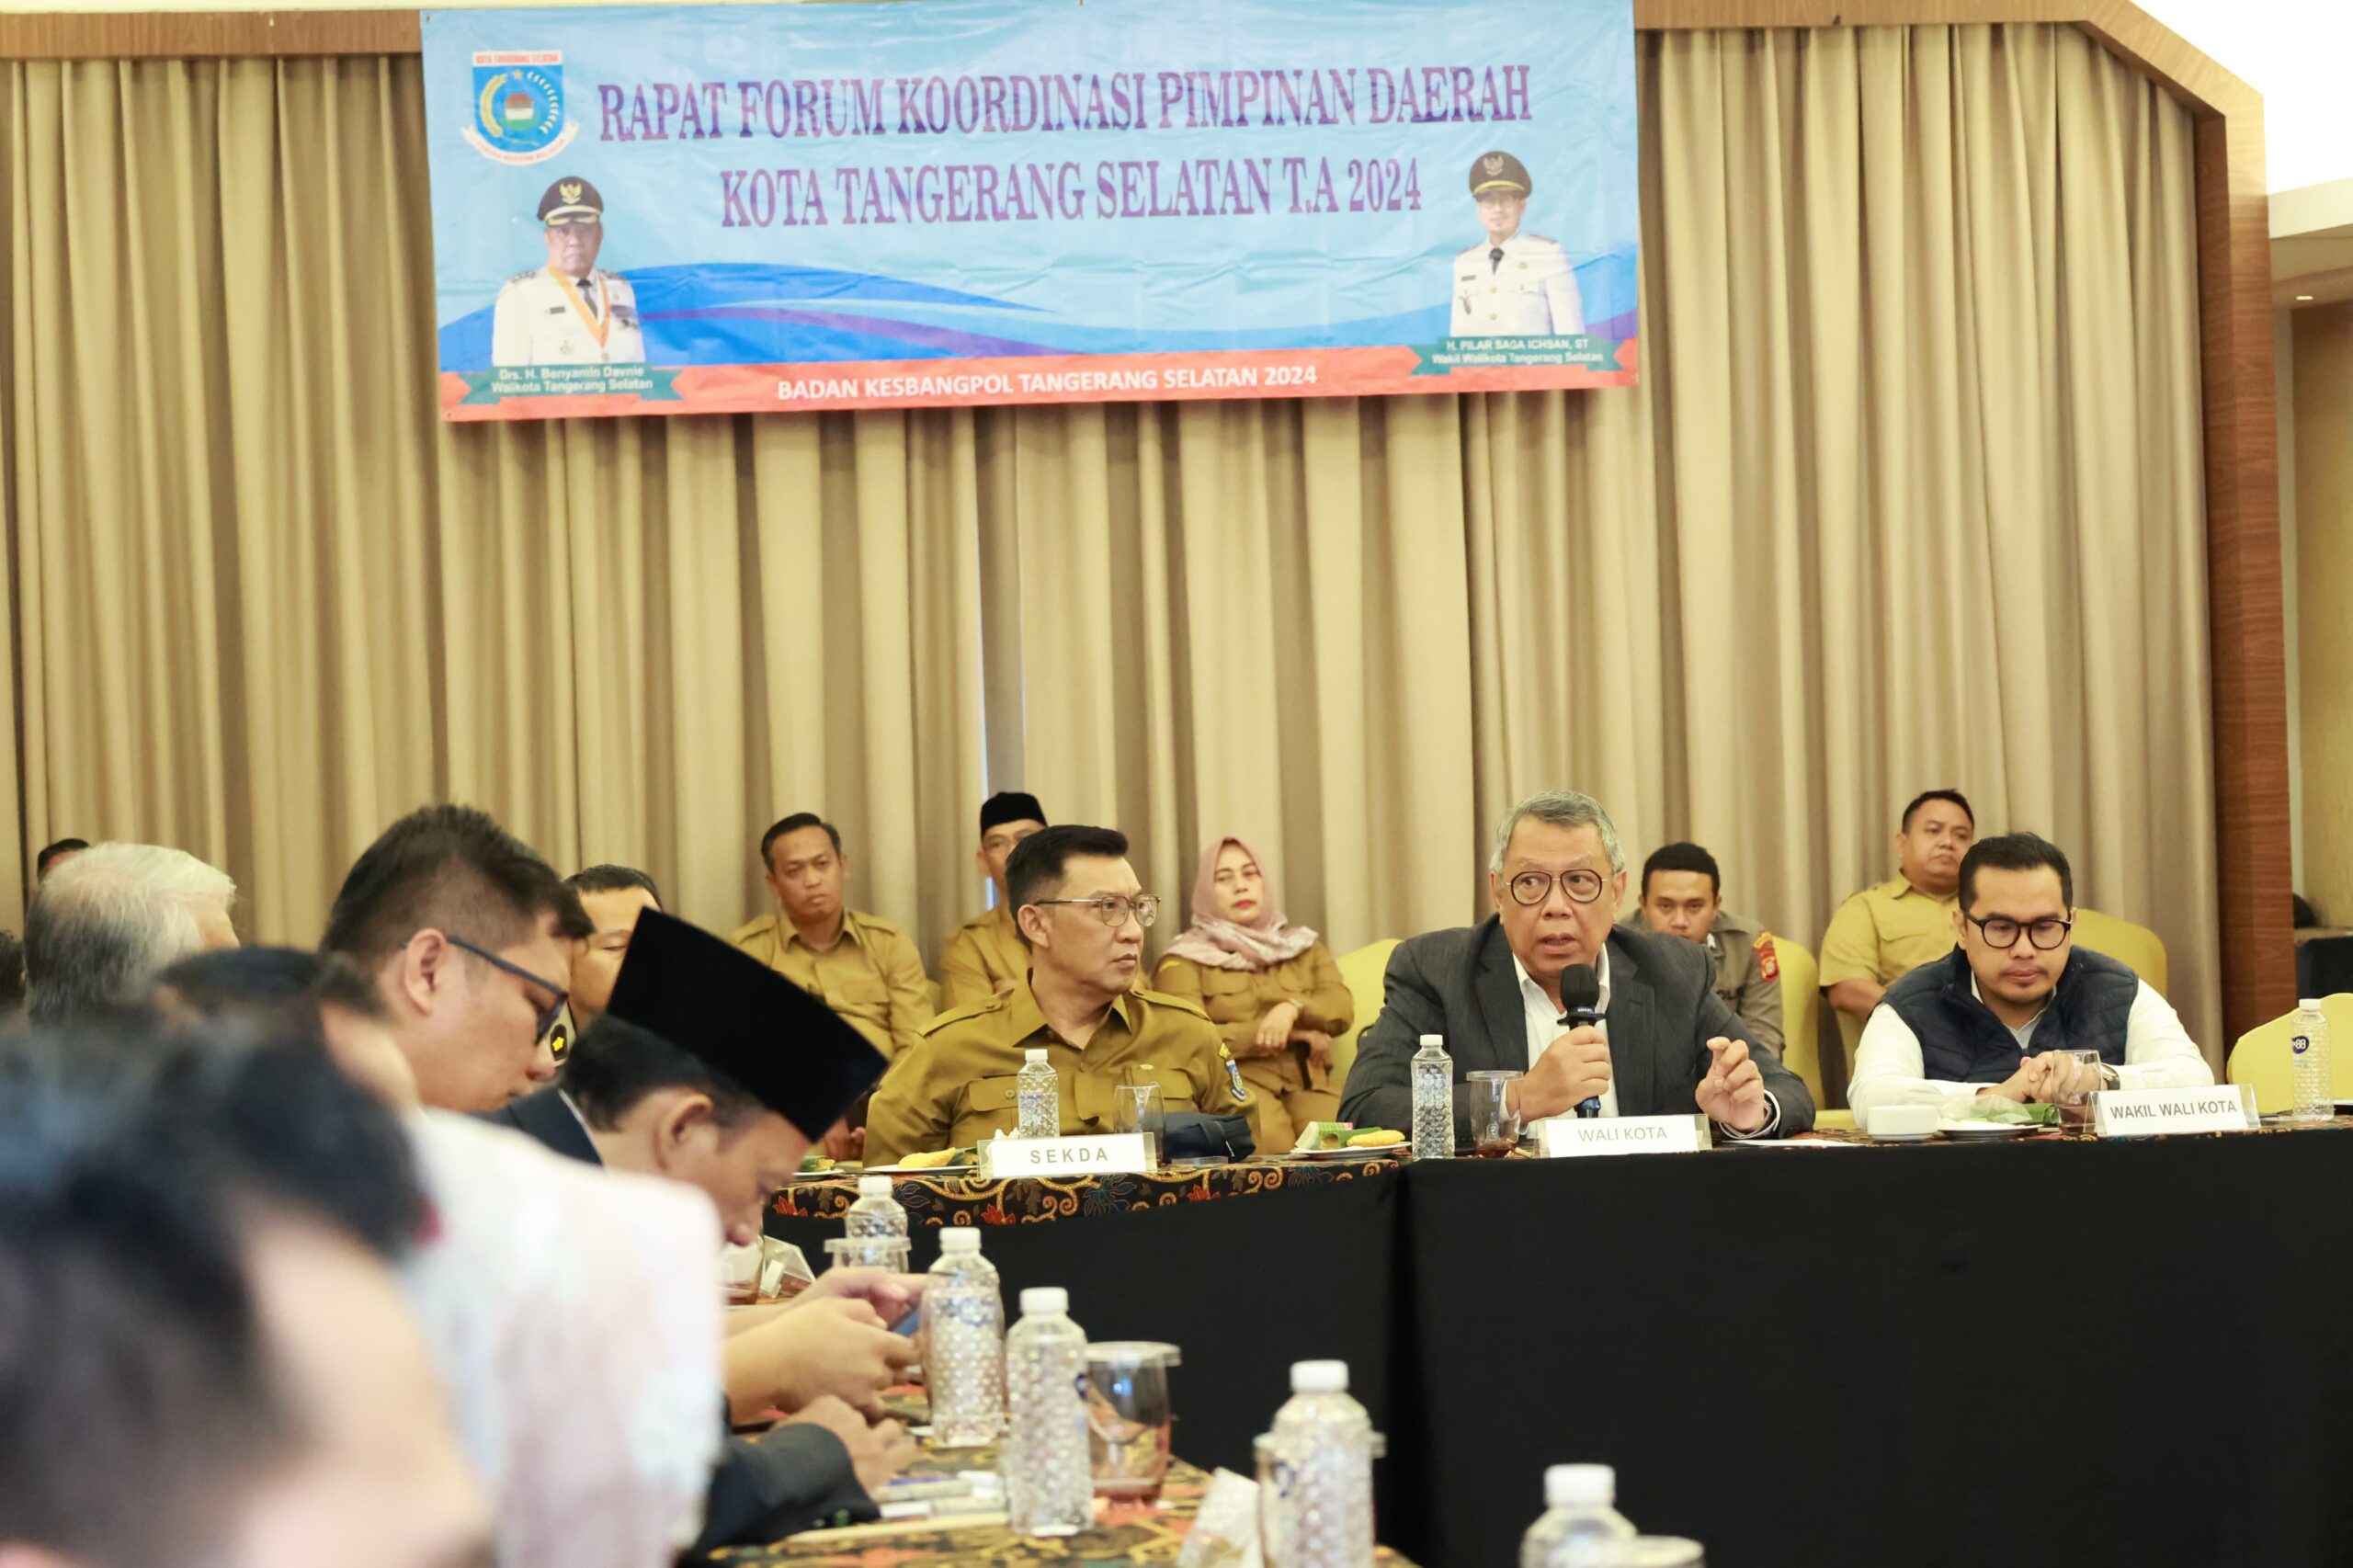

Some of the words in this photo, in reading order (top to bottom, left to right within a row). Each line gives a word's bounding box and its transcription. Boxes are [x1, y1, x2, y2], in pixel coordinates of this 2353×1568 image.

[597, 82, 727, 142] RAPAT
[737, 78, 886, 139] FORUM
[895, 72, 1147, 134] KOORDINASI
[1157, 67, 1357, 128] PIMPINAN
[1367, 64, 1532, 124] DAERAH
[720, 167, 829, 228] KOTA
[835, 161, 1086, 224] TANGERANG
[1096, 156, 1272, 221] SELATAN
[1282, 156, 1340, 214] T.A
[1347, 156, 1422, 213] 2024
[1446, 340, 1458, 351] H.
[1460, 339, 1492, 351] PILAR
[1495, 338, 1526, 350] SAGA
[1574, 337, 1589, 349] ST
[1431, 353, 1461, 365] Wakil
[1462, 352, 1507, 365] Walikota
[1509, 351, 1563, 366] Tangerang
[1565, 350, 1604, 363] Selatan
[498, 369, 521, 381] Drs.
[525, 369, 538, 381] H.
[540, 366, 601, 381] Benyamin
[777, 378, 858, 400] BADAN
[864, 374, 1014, 398] KESBANGPOL
[1018, 369, 1158, 393] TANGERANG
[1163, 366, 1257, 389] SELATAN
[1263, 364, 1318, 386] 2024
[491, 381, 540, 393] Walikota
[543, 380, 606, 394] Tangerang
[608, 378, 654, 391] Selatan
[2109, 1104, 2157, 1119] WAKIL
[2159, 1102, 2196, 1117] WALI
[2198, 1099, 2238, 1115] KOTA
[1577, 1128, 1619, 1142] WALI
[1623, 1126, 1668, 1141] KOTA
[1029, 1147, 1108, 1165] SEKDA
